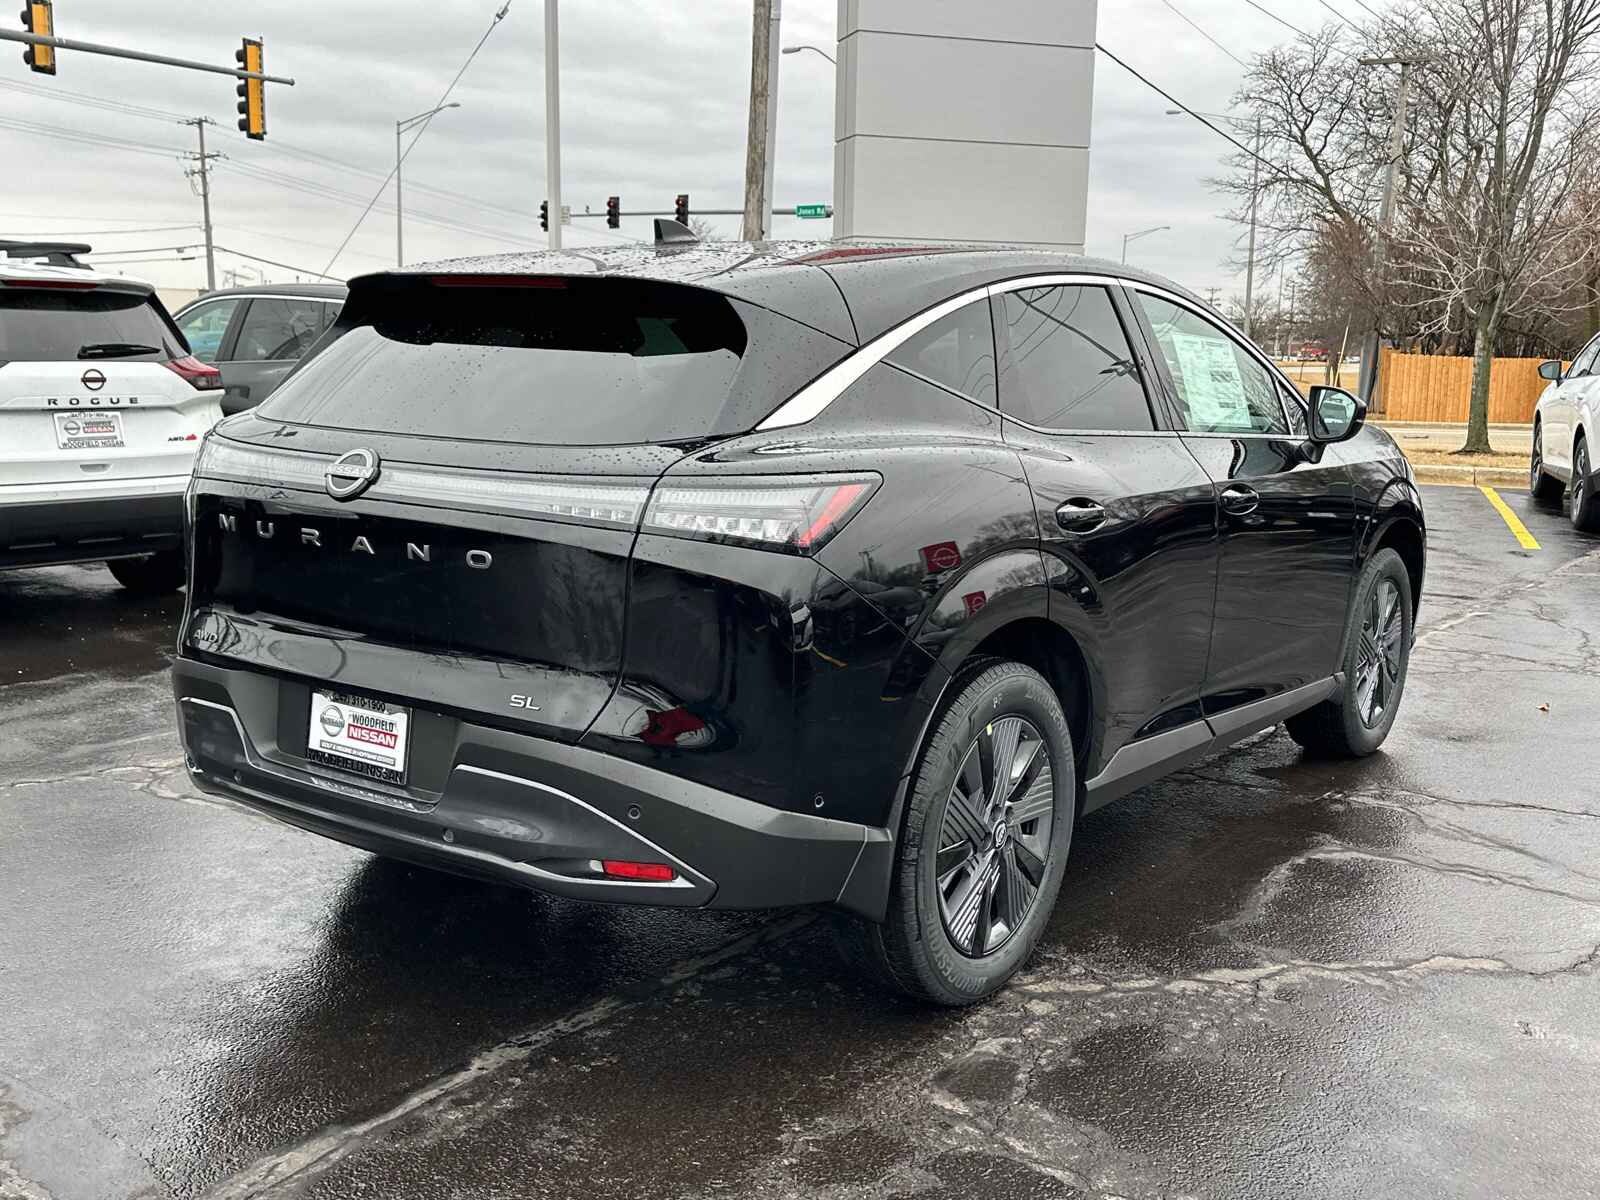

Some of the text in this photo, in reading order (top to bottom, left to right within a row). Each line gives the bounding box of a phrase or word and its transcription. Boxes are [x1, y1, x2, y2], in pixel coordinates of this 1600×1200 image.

[799, 207, 825, 215] Jones Rd
[47, 397, 139, 406] ROGUE
[62, 440, 125, 449] WOODFIELD NISSAN
[218, 513, 493, 569] MURANO
[194, 629, 218, 642] AWD
[509, 694, 541, 711] SL
[352, 712, 394, 732] WOODFIELD
[349, 727, 395, 747] NISSAN
[366, 763, 403, 784] NISSAN
